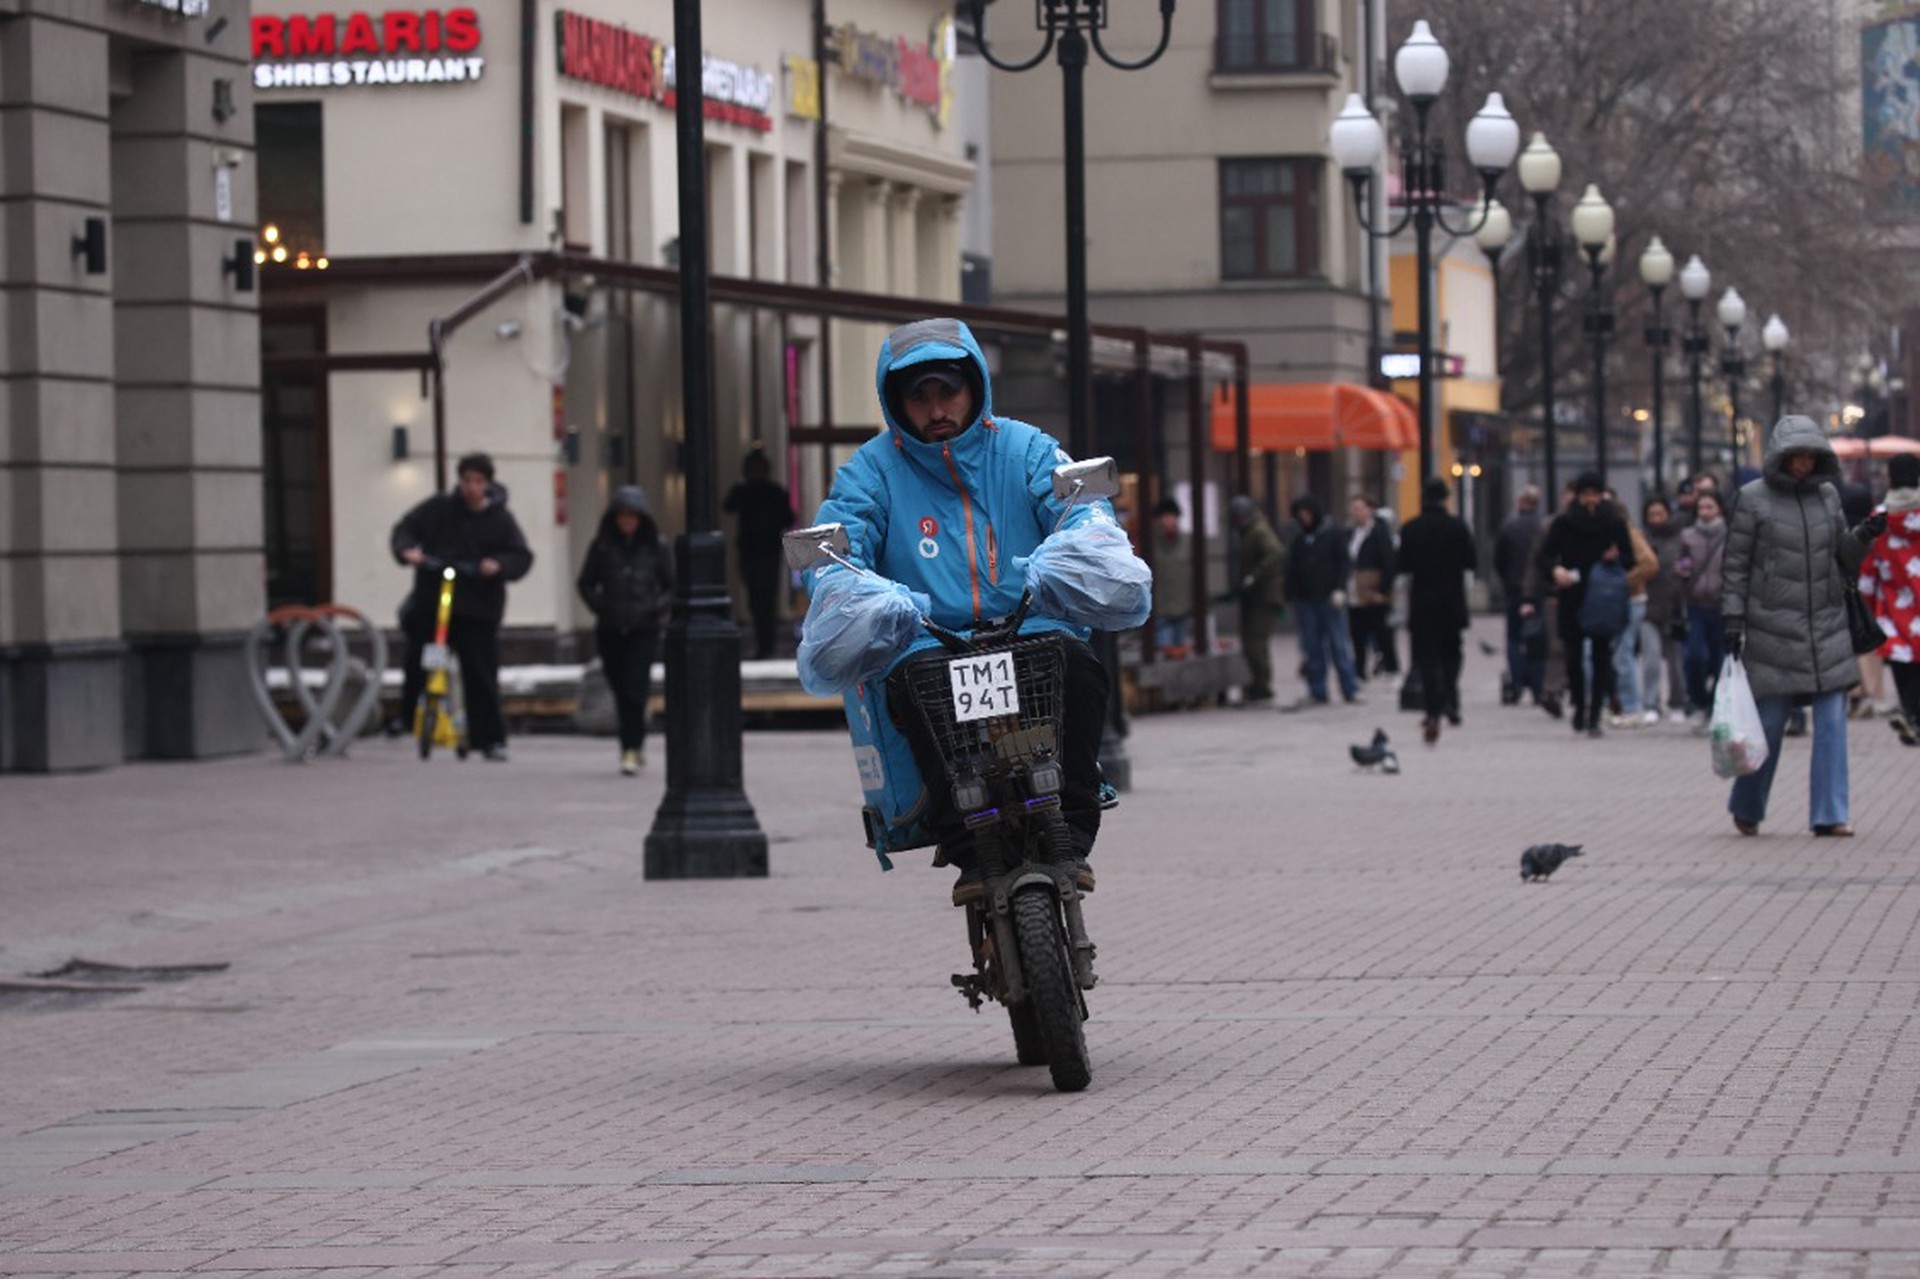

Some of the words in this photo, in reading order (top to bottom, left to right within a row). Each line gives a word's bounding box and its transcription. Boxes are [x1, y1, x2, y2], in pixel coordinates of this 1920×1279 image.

[254, 57, 484, 88] SHRESTAURANT
[952, 659, 1009, 687] TM1
[958, 685, 1014, 714] 94T
